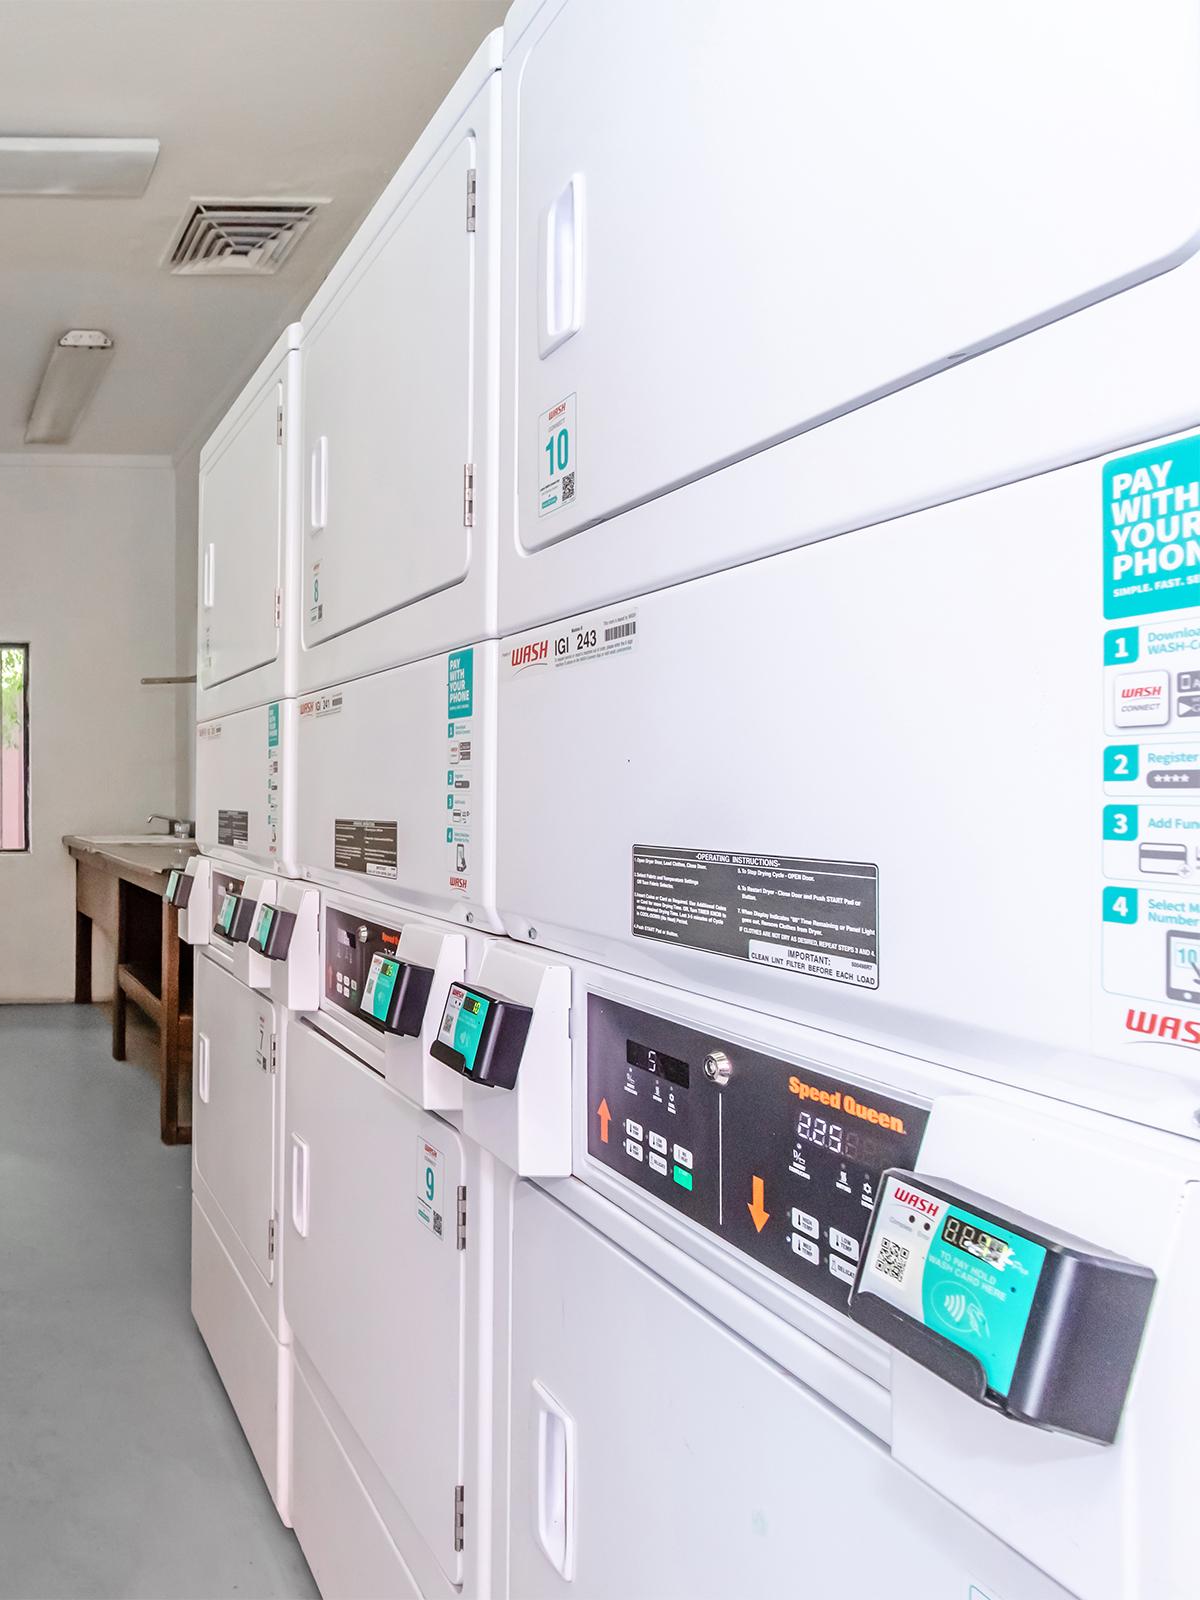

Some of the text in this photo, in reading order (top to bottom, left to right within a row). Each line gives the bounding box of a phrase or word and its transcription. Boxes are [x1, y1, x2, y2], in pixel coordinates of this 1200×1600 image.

[548, 402, 566, 420] WASH
[545, 428, 569, 476] 10
[1112, 460, 1174, 500] PAY
[1110, 481, 1199, 526] WITH
[1110, 510, 1200, 552] YOUR
[313, 579, 320, 602] 8
[1112, 584, 1154, 598] SIMPLE.
[1154, 577, 1185, 592] FAST.
[511, 640, 548, 666] WASH
[554, 636, 569, 656] IGI
[576, 630, 597, 650] 243
[1114, 637, 1129, 658] 1
[450, 658, 461, 671] PAY
[450, 668, 464, 682] WITH
[450, 680, 466, 692] YOUR
[1121, 686, 1162, 699] WASH
[450, 690, 470, 704] PHONE
[300, 701, 314, 714] WASH
[1120, 702, 1161, 712] CONNECT
[1113, 754, 1129, 774] 2
[1148, 752, 1198, 766] Register
[1112, 813, 1128, 834] 3
[1148, 818, 1172, 829] Add
[450, 876, 468, 889] WASH
[758, 870, 771, 878] Drying
[813, 894, 826, 902] Push
[826, 896, 843, 904] START
[844, 898, 854, 906] Pad
[1112, 896, 1128, 916] 4
[1148, 898, 1186, 912] Select
[754, 910, 769, 919] Display
[813, 920, 839, 931] Remaining
[846, 924, 861, 933] Panel
[1148, 912, 1199, 926] Number
[819, 940, 838, 949] REPEAT
[838, 944, 855, 953] STEPS
[788, 950, 831, 966] IMPORTANT:
[751, 952, 876, 986] CLEAN LINT FILTER BEFORE EACH LOAD
[788, 1076, 906, 1134] Speed Queen
[426, 1167, 434, 1201] 9
[894, 1187, 940, 1217] WASH
[840, 1235, 851, 1246] LOW
[840, 1240, 852, 1252] TEMP
[940, 1250, 997, 1285] TO PAY HOLD
[928, 1255, 1008, 1302] WASH CARD HERE
